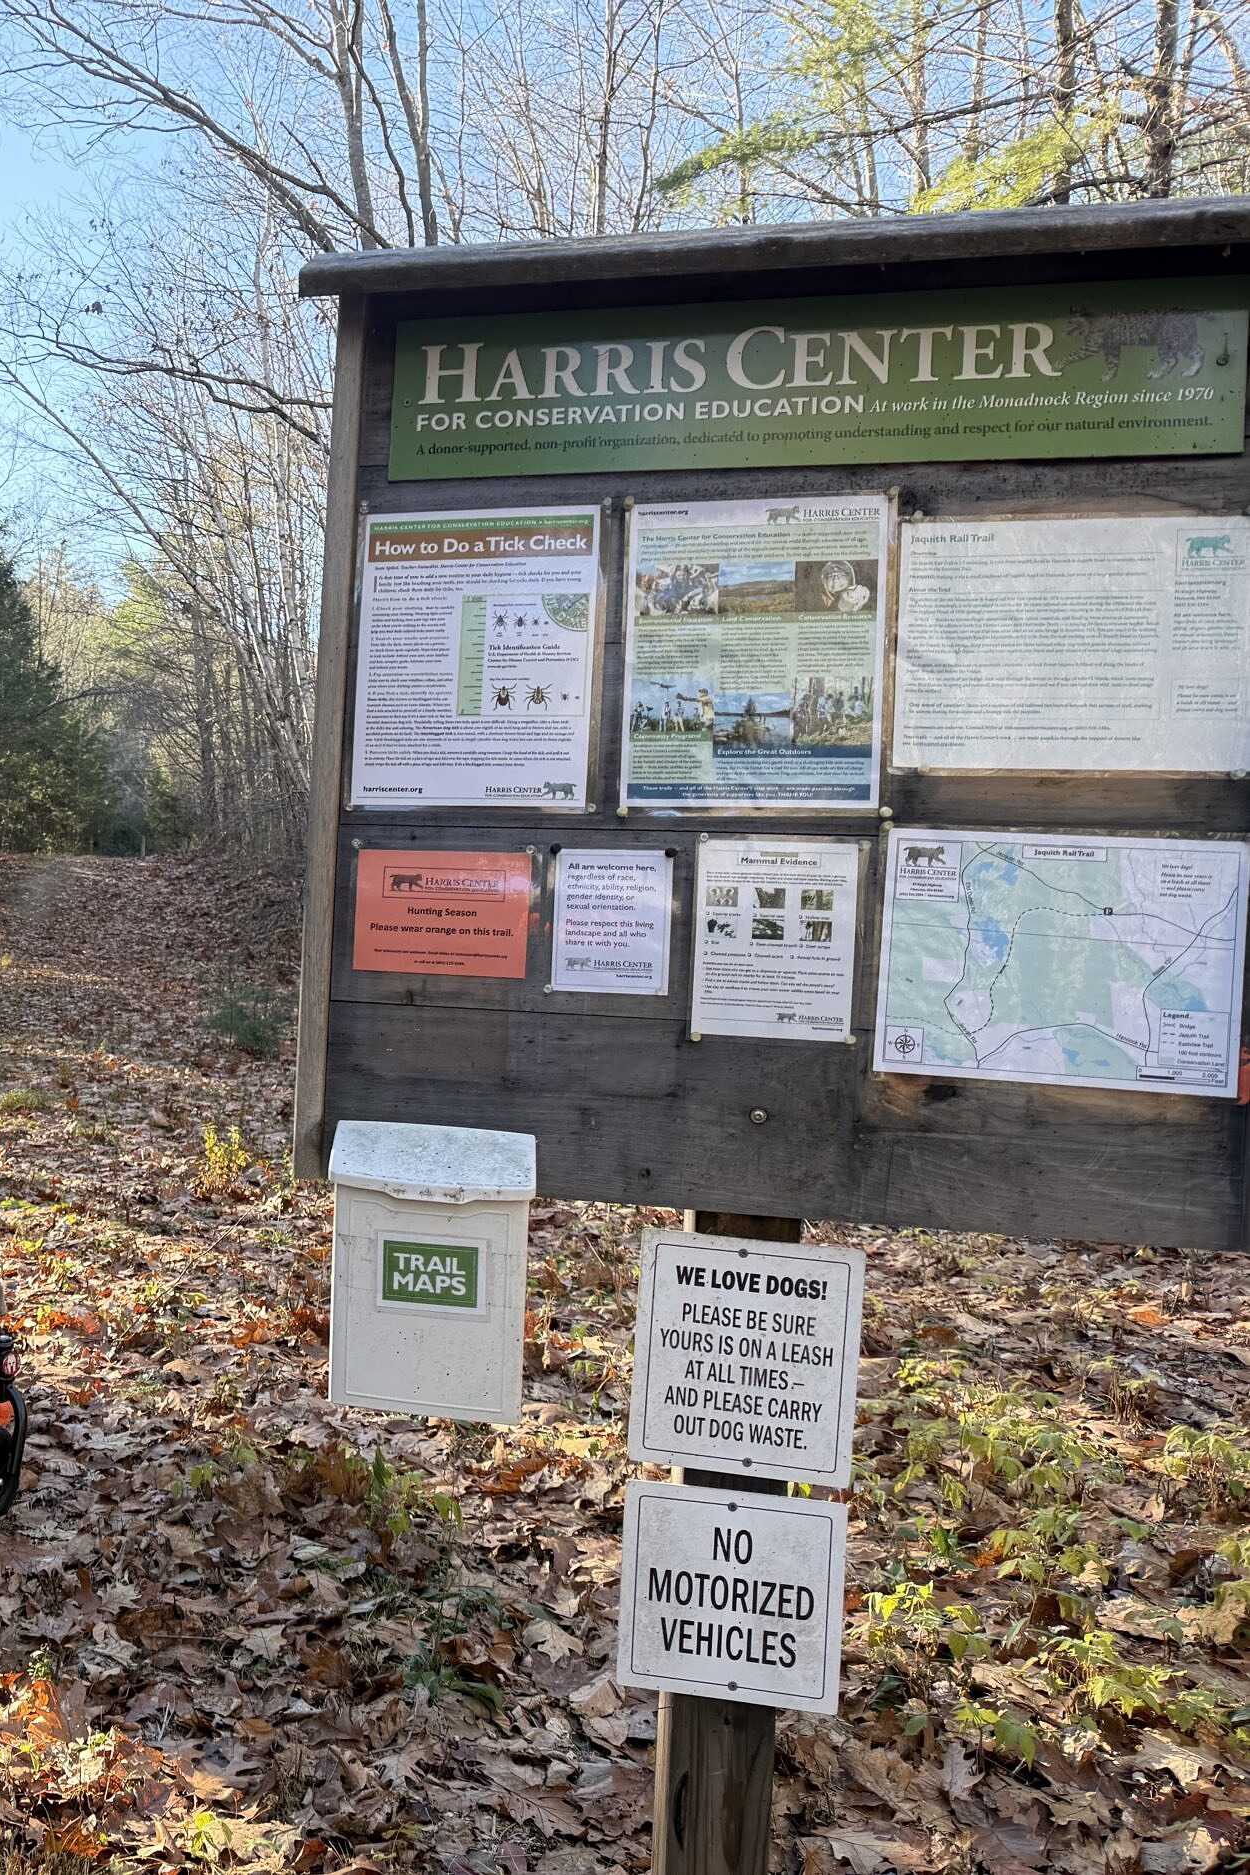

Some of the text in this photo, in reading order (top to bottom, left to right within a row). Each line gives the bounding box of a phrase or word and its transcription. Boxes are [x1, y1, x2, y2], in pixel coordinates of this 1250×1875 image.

[418, 323, 1062, 404] HARRIS CENTER
[869, 386, 1214, 414] At work in the Monadnock Region since 1970
[416, 394, 864, 432] FOR CONSERVATION EDUCATION
[416, 415, 1213, 457] A donor-supported, non-profit organization, dedicated to promoting understanding and respect for our natural environment.
[638, 509, 689, 517] harriscenter.org
[803, 507, 880, 518] HARRIS CENTER
[442, 521, 494, 529] CONSERVATION
[496, 519, 537, 527] EDUCATION
[712, 532, 757, 540] Conservation
[758, 531, 791, 539] Education
[910, 533, 995, 545] Jaquith Rail Trail
[375, 533, 588, 556] How to Do a Tick Check
[1181, 558, 1246, 567] HARRIS CENTER
[362, 785, 423, 794] harriscenter.org
[485, 786, 542, 794] HARRIS CENTER
[1034, 848, 1095, 858] Jaquith Rail Trail
[740, 857, 818, 866] Mammal Evidence
[636, 864, 657, 872] here,
[900, 867, 957, 877] HARRIS CENTER
[425, 876, 499, 888] HARRIS CENTER
[567, 873, 605, 881] regardless
[601, 884, 626, 892] ability,
[626, 885, 657, 893] religion,
[566, 893, 593, 901] gender
[594, 893, 624, 901] identity,
[407, 906, 477, 917] Hunting Season
[591, 903, 636, 911] orientation.
[565, 918, 589, 926] Please
[590, 920, 618, 928] respect
[635, 920, 654, 930] living
[370, 923, 399, 932] Please
[400, 925, 424, 933] wear
[425, 926, 457, 936] orange
[473, 925, 491, 936] this
[492, 927, 514, 937] trail.
[565, 929, 601, 938] landscape
[613, 941, 630, 949] you.
[593, 959, 653, 969] HARRIS CENTER
[1162, 1011, 1190, 1020] Legend
[393, 1252, 466, 1275] TRAIL
[393, 1271, 467, 1296] MAPS
[676, 1265, 828, 1300] WE LOVE DOGS!
[682, 1302, 817, 1337] PLEASE BE SURE
[660, 1328, 834, 1367] YOURS IS ON A LEASH
[684, 1359, 704, 1380] AT
[706, 1362, 735, 1384] ALL
[664, 1385, 822, 1423] AND PLEASE CARRY
[673, 1414, 807, 1450] OUT DOG WASTE.
[712, 1526, 753, 1565] NO
[648, 1567, 815, 1621] MOTORIZED
[661, 1617, 796, 1668] VEHICLES
